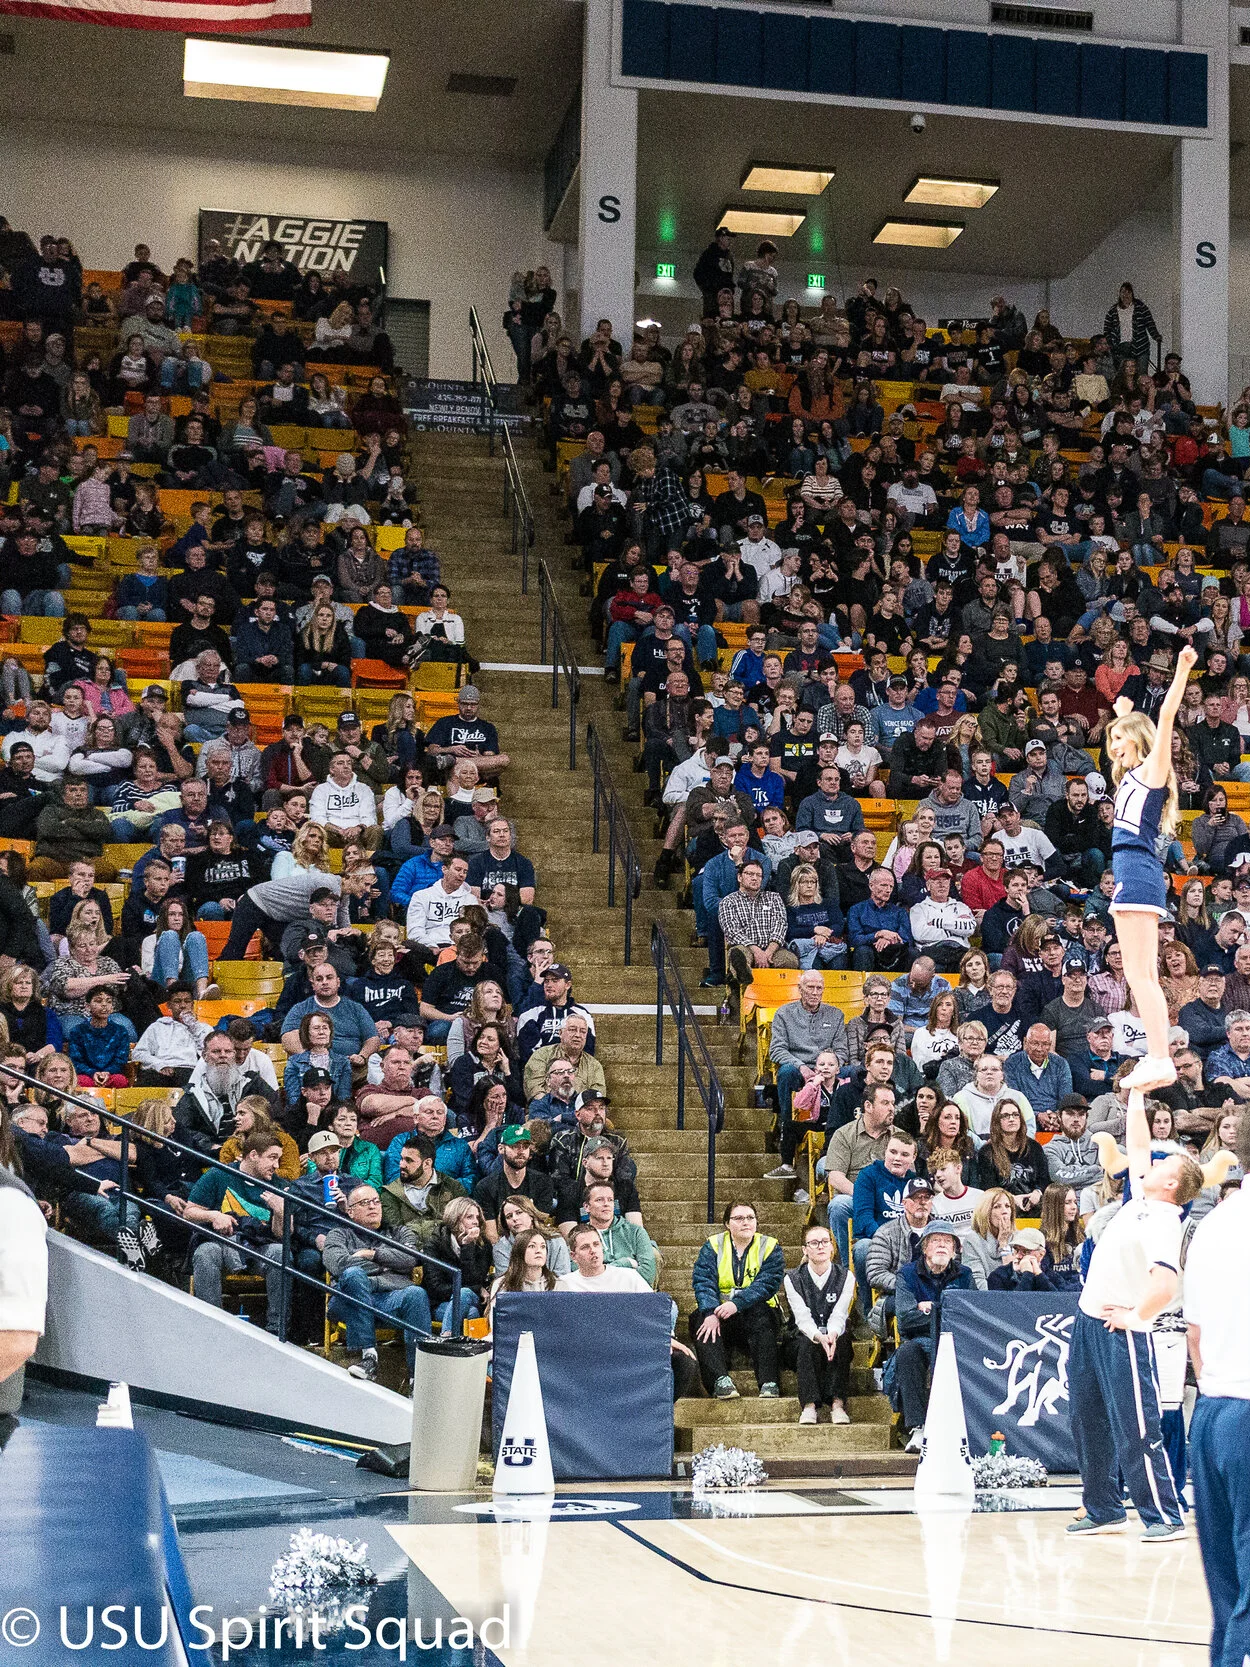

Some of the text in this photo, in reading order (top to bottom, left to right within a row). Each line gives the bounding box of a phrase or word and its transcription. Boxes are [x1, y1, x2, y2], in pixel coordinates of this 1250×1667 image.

[597, 195, 620, 223] S
[224, 214, 366, 248] #AGGIE
[234, 241, 358, 272] NTION
[1195, 241, 1217, 268] S
[656, 263, 676, 278] EXIT
[807, 273, 826, 288] EXIT
[413, 413, 432, 422] FREE
[433, 414, 475, 425] BREAKFAST
[457, 728, 487, 744] State
[1005, 852, 1032, 863] STATE
[501, 1446, 537, 1458] STATE
